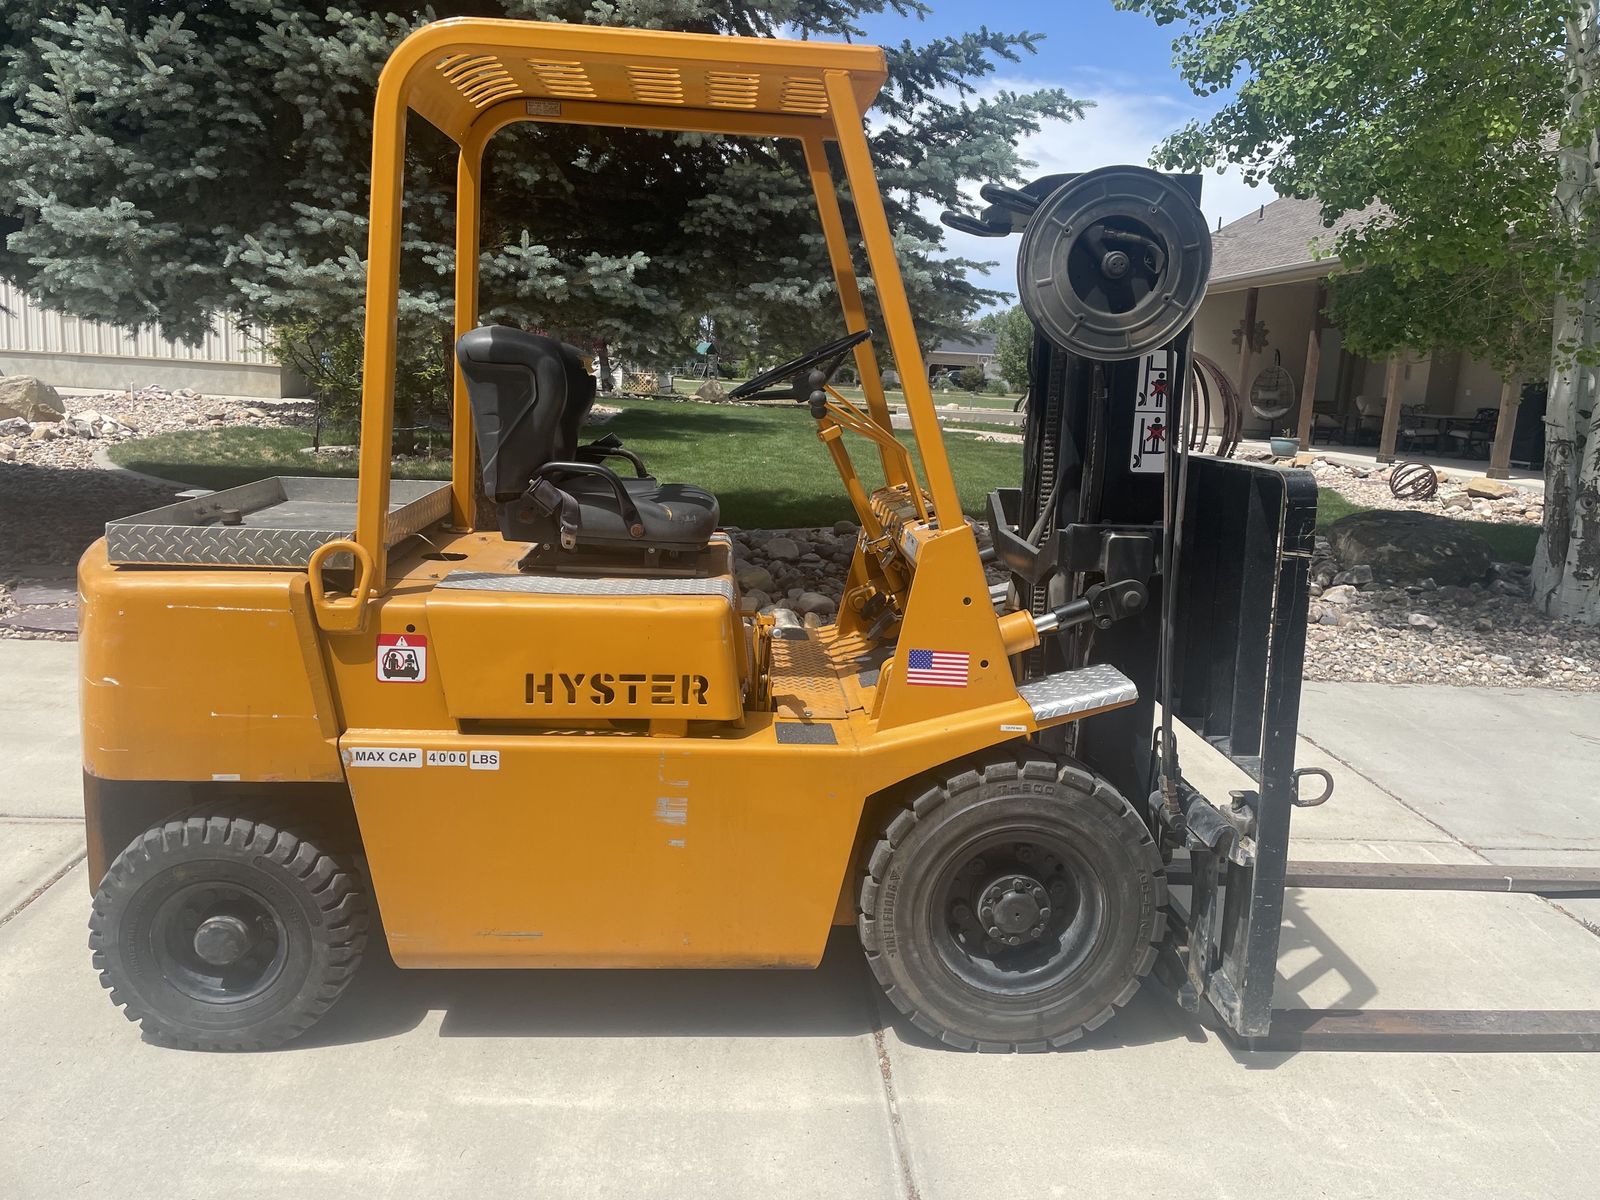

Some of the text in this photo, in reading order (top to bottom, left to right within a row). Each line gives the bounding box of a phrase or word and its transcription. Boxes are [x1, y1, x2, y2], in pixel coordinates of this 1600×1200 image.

[525, 673, 709, 705] HYSTER
[355, 751, 498, 765] MAX CAP 4000 LBS
